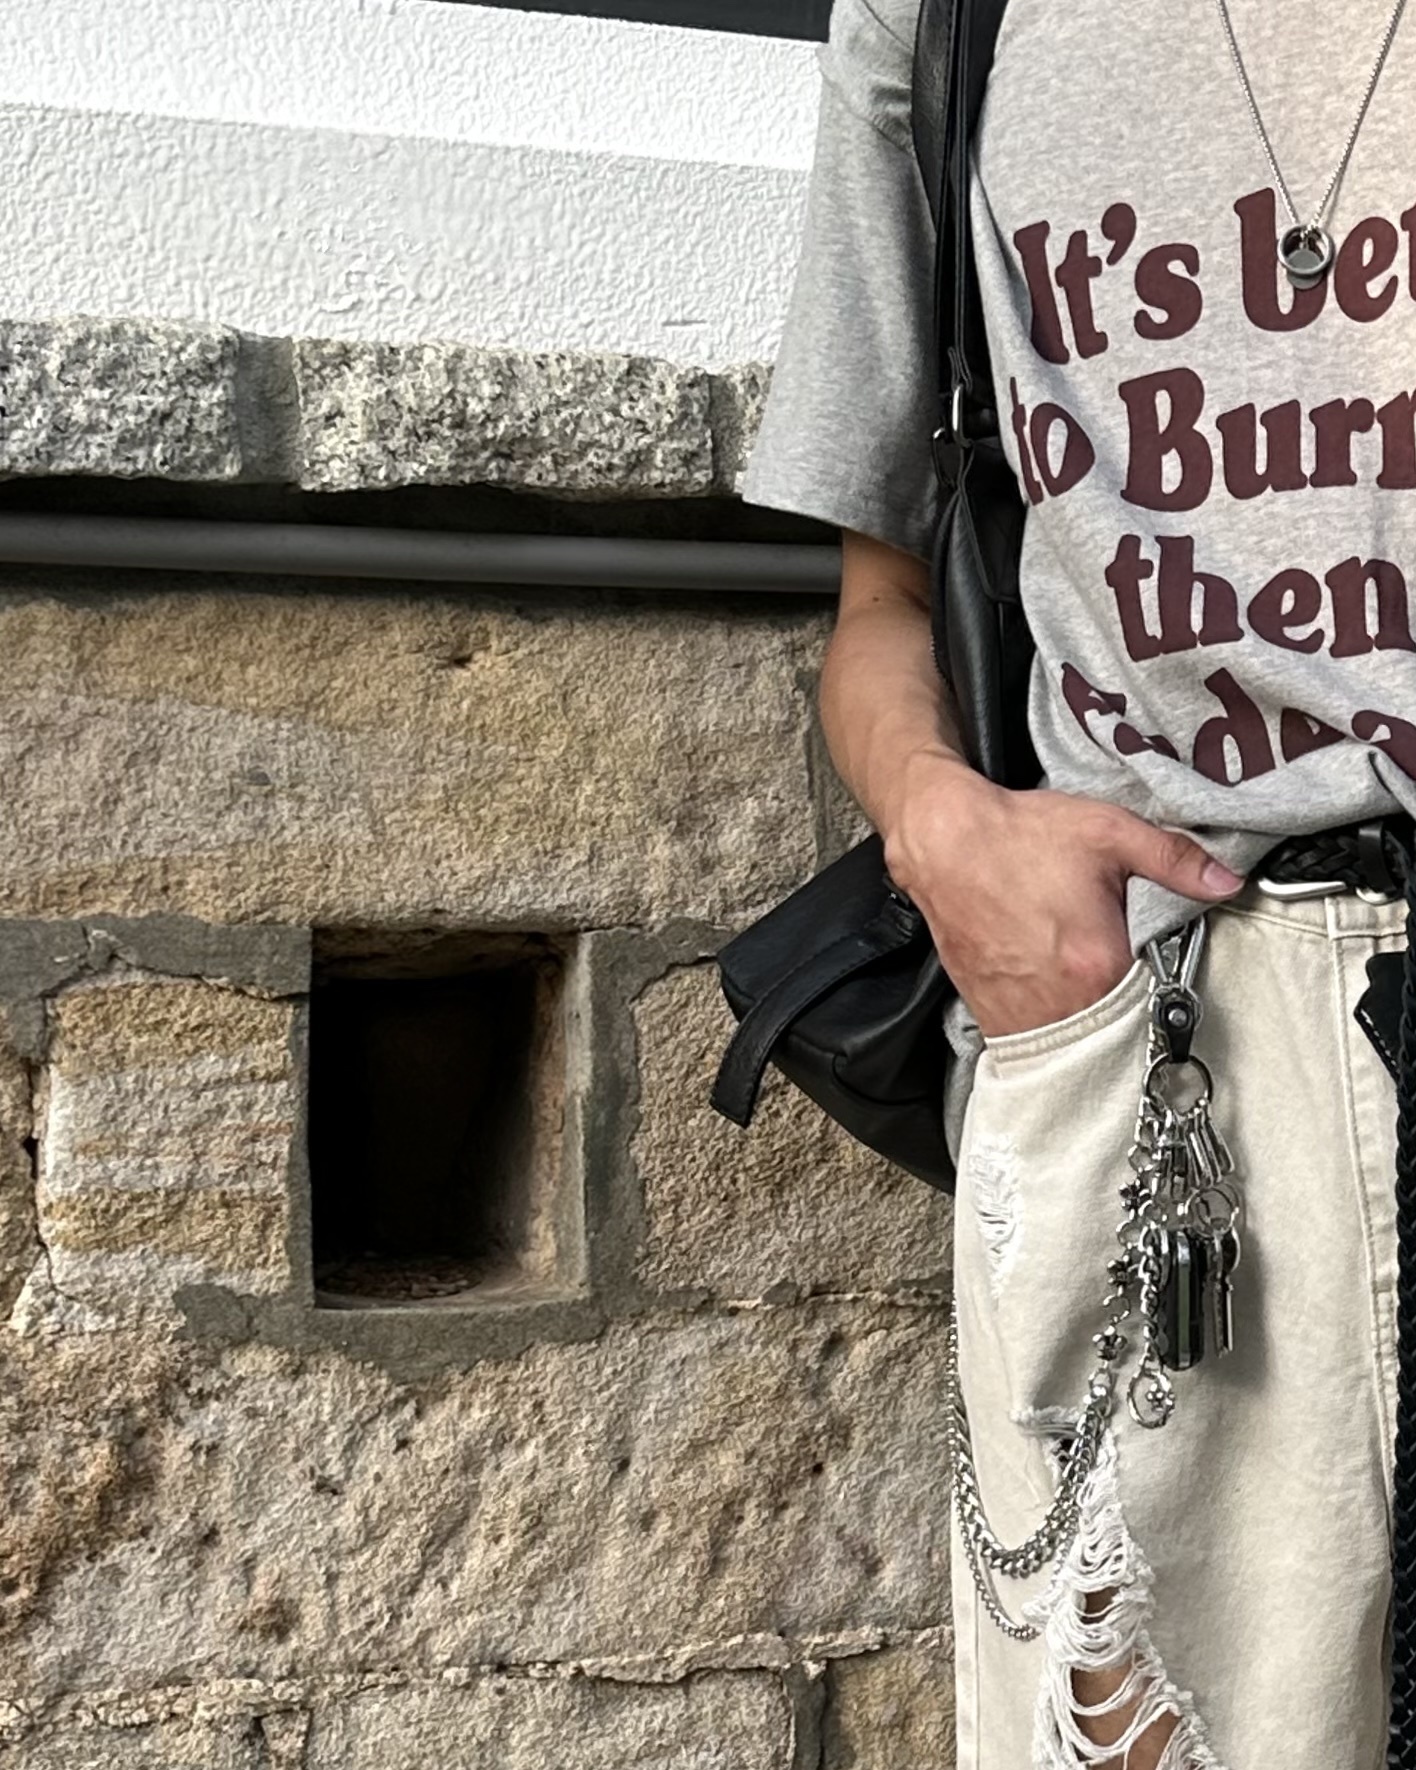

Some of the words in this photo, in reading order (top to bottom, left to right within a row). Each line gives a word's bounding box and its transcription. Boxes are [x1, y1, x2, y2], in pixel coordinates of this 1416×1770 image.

[1014, 202, 1204, 364] It's
[1009, 376, 1095, 506] to
[1104, 533, 1416, 662] then
